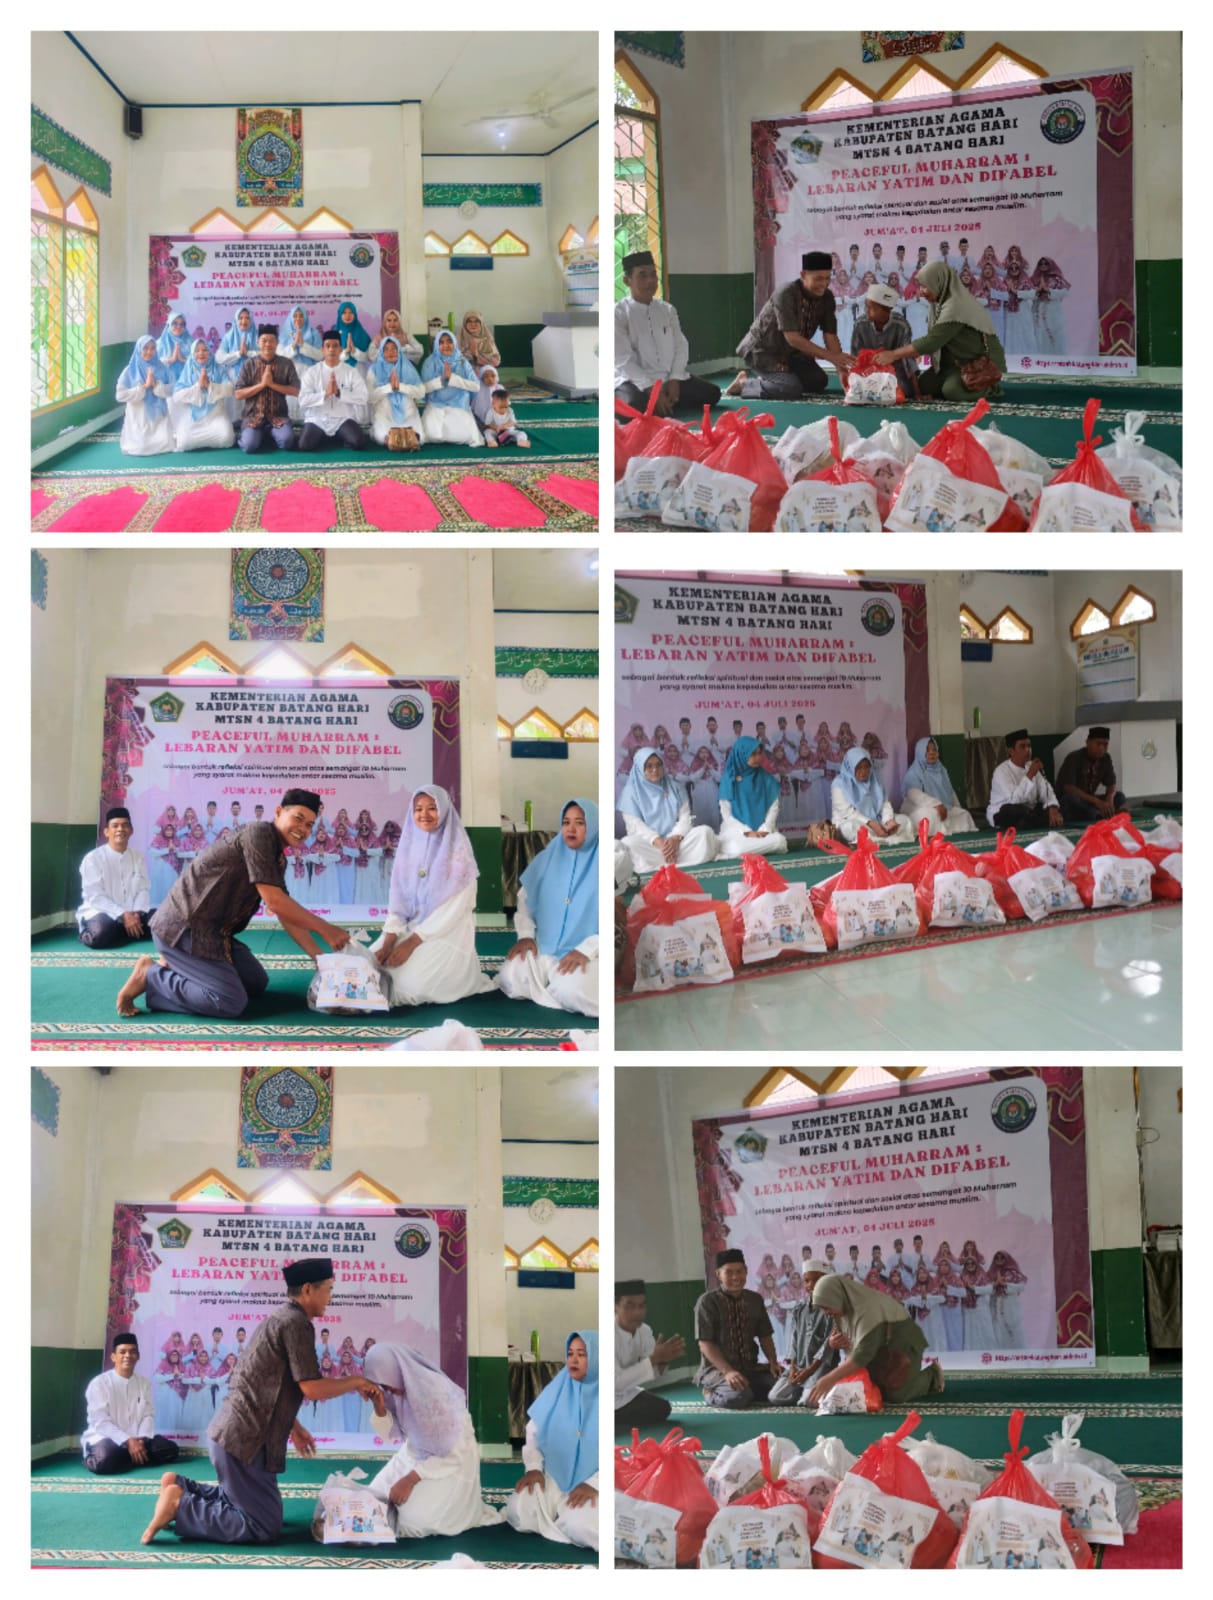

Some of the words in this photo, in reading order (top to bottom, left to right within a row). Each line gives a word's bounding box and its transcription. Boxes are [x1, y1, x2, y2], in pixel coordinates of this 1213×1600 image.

[846, 114, 944, 134] KEMENTERIAN
[950, 107, 1005, 123] AGAMA
[834, 130, 912, 148] KABUPATEN
[917, 123, 976, 139] BATANG
[981, 118, 1018, 132] HARI
[853, 147, 889, 159] MTSN
[894, 146, 900, 155] 4
[905, 139, 963, 154] BATANG
[968, 135, 1003, 148] HARI
[832, 163, 911, 179] PEACEFUL
[916, 154, 1018, 172] MUHARRAM
[807, 180, 877, 195] LEBARAN
[882, 175, 934, 189] YATIM
[940, 172, 973, 185] DAN
[980, 166, 1056, 182] DIFABEL
[668, 587, 776, 601] KEMENTERIAN
[781, 592, 832, 604] AGAMA
[652, 599, 744, 613] KABUPATEN
[749, 603, 806, 615] BATANG
[811, 606, 843, 616] HARI
[677, 615, 719, 627] MTSN
[725, 617, 732, 627] 4
[737, 617, 794, 629] BATANG
[800, 620, 832, 630] HARI
[652, 634, 744, 646] PEACEFUL
[749, 637, 844, 649] MUHARRAM
[621, 648, 707, 661] LEBARAN
[713, 650, 768, 662] YATIM
[774, 651, 807, 662] DAN
[811, 652, 876, 663] DIFABEL
[210, 691, 305, 702] KEMENTERIAN
[310, 692, 358, 702] AGAMA
[196, 702, 274, 712] KABUPATEN
[279, 703, 332, 713] BATANG
[337, 704, 369, 713] HARI
[214, 715, 251, 724] MTSN
[256, 715, 262, 725] 4
[267, 715, 321, 725] BATANG
[325, 715, 357, 726] HARI
[191, 730, 272, 741] PEACEFUL
[276, 731, 368, 742] MUHARRAM
[164, 742, 237, 753] LEBARAN
[243, 743, 294, 754] YATIM
[299, 744, 330, 754] DAN
[335, 744, 401, 754] DIFABEL
[792, 1105, 892, 1130] KEMENTERIAN
[897, 1096, 954, 1115] AGAMA
[779, 1122, 860, 1145] KABUPATEN
[865, 1113, 925, 1133] BATANG
[930, 1107, 968, 1124] HARI
[799, 1141, 837, 1157] MTSN
[842, 1140, 848, 1152] 4
[854, 1131, 912, 1150] BATANG
[918, 1126, 955, 1142] HARI
[779, 1158, 859, 1179] PEACEFUL
[865, 1145, 970, 1168] MUHARRAM
[754, 1177, 826, 1196] LEBARAN
[831, 1170, 885, 1187] YATIM
[890, 1165, 925, 1181] DAN
[930, 1155, 1009, 1176] DIFABEL
[217, 1219, 312, 1230] KEMENTERIAN
[316, 1220, 365, 1231] AGAMA
[203, 1229, 281, 1239] KABUPATEN
[286, 1230, 339, 1240] BATANG
[344, 1231, 376, 1241] HARI
[222, 1241, 259, 1252] MTSN
[263, 1242, 270, 1252] 4
[274, 1242, 328, 1252] BATANG
[332, 1243, 364, 1253] HARI
[199, 1257, 279, 1268] PEACEFUL
[172, 1269, 244, 1280] LEBARAN
[342, 1272, 407, 1283] DIFABEL
